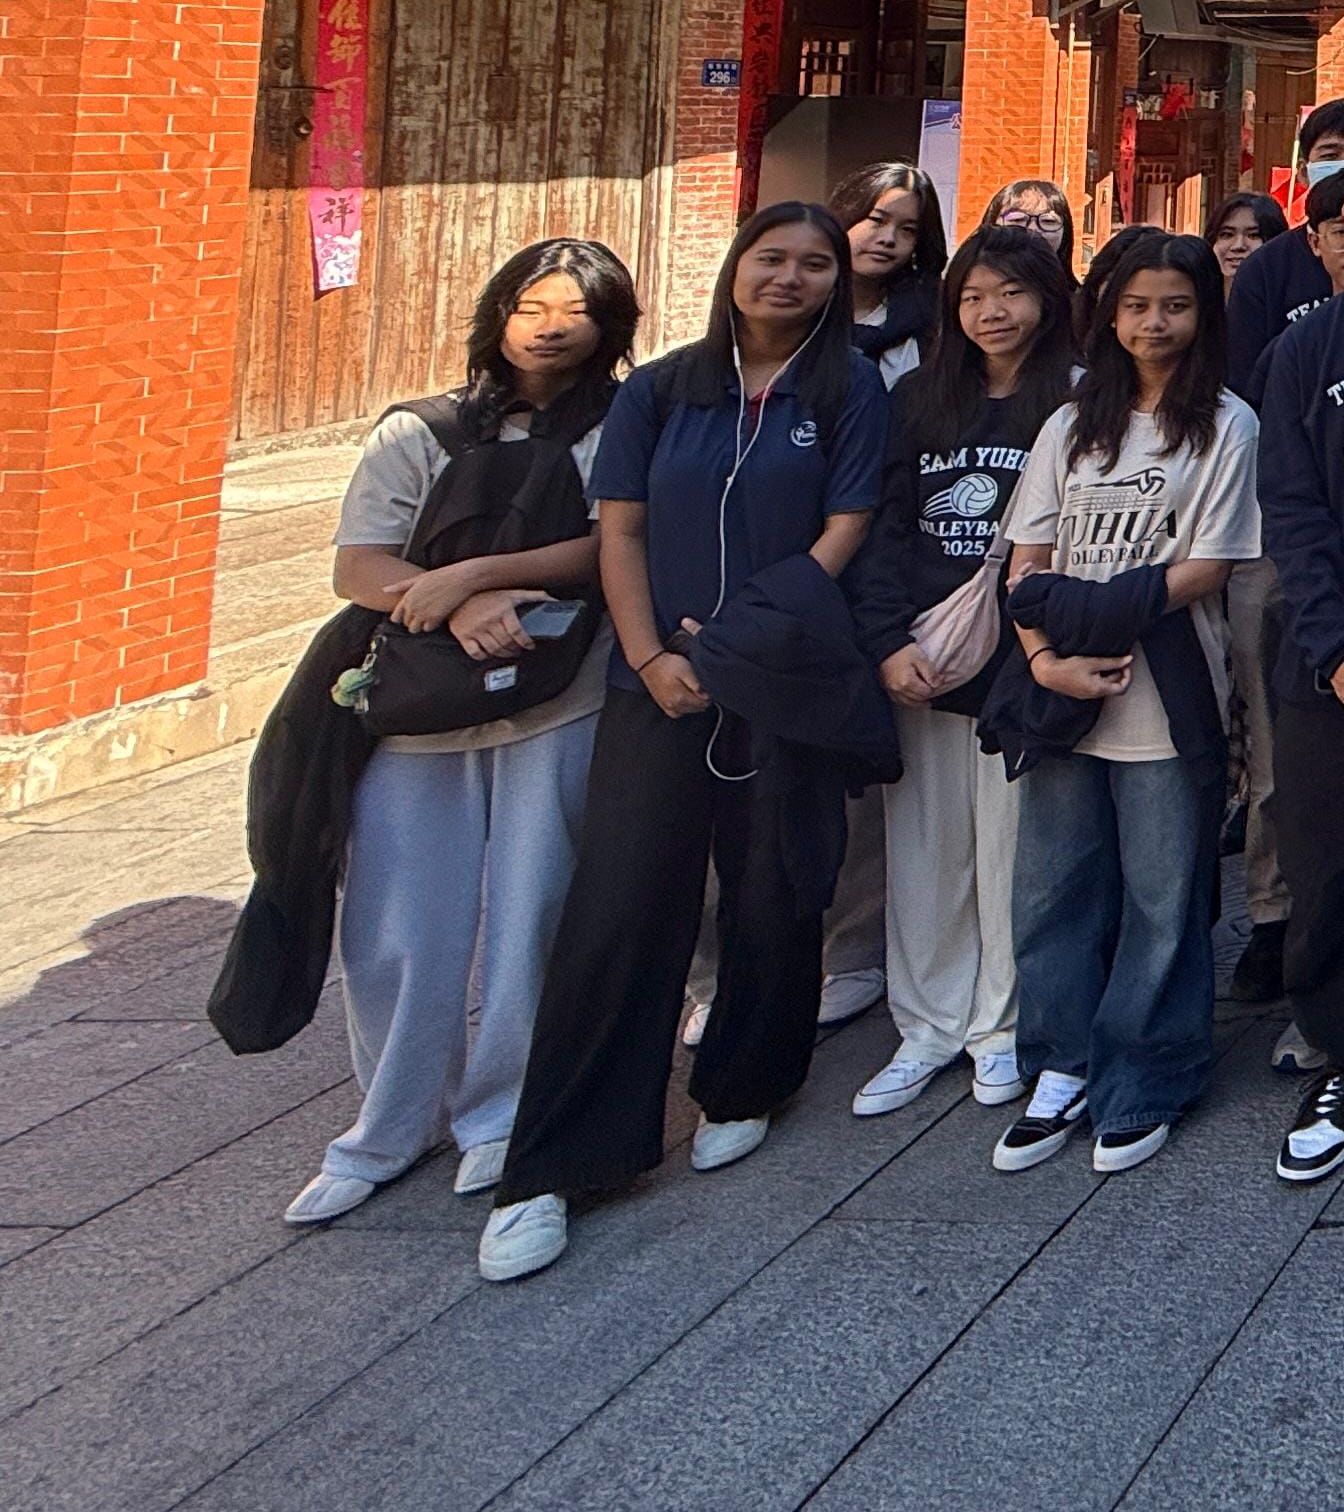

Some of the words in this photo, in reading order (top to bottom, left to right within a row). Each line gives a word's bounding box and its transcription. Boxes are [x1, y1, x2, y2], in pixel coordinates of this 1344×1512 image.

[709, 71, 731, 84] 296
[920, 447, 967, 475] EAM
[941, 540, 985, 556] 2025
[1071, 543, 1159, 566] OLLEYBALL
